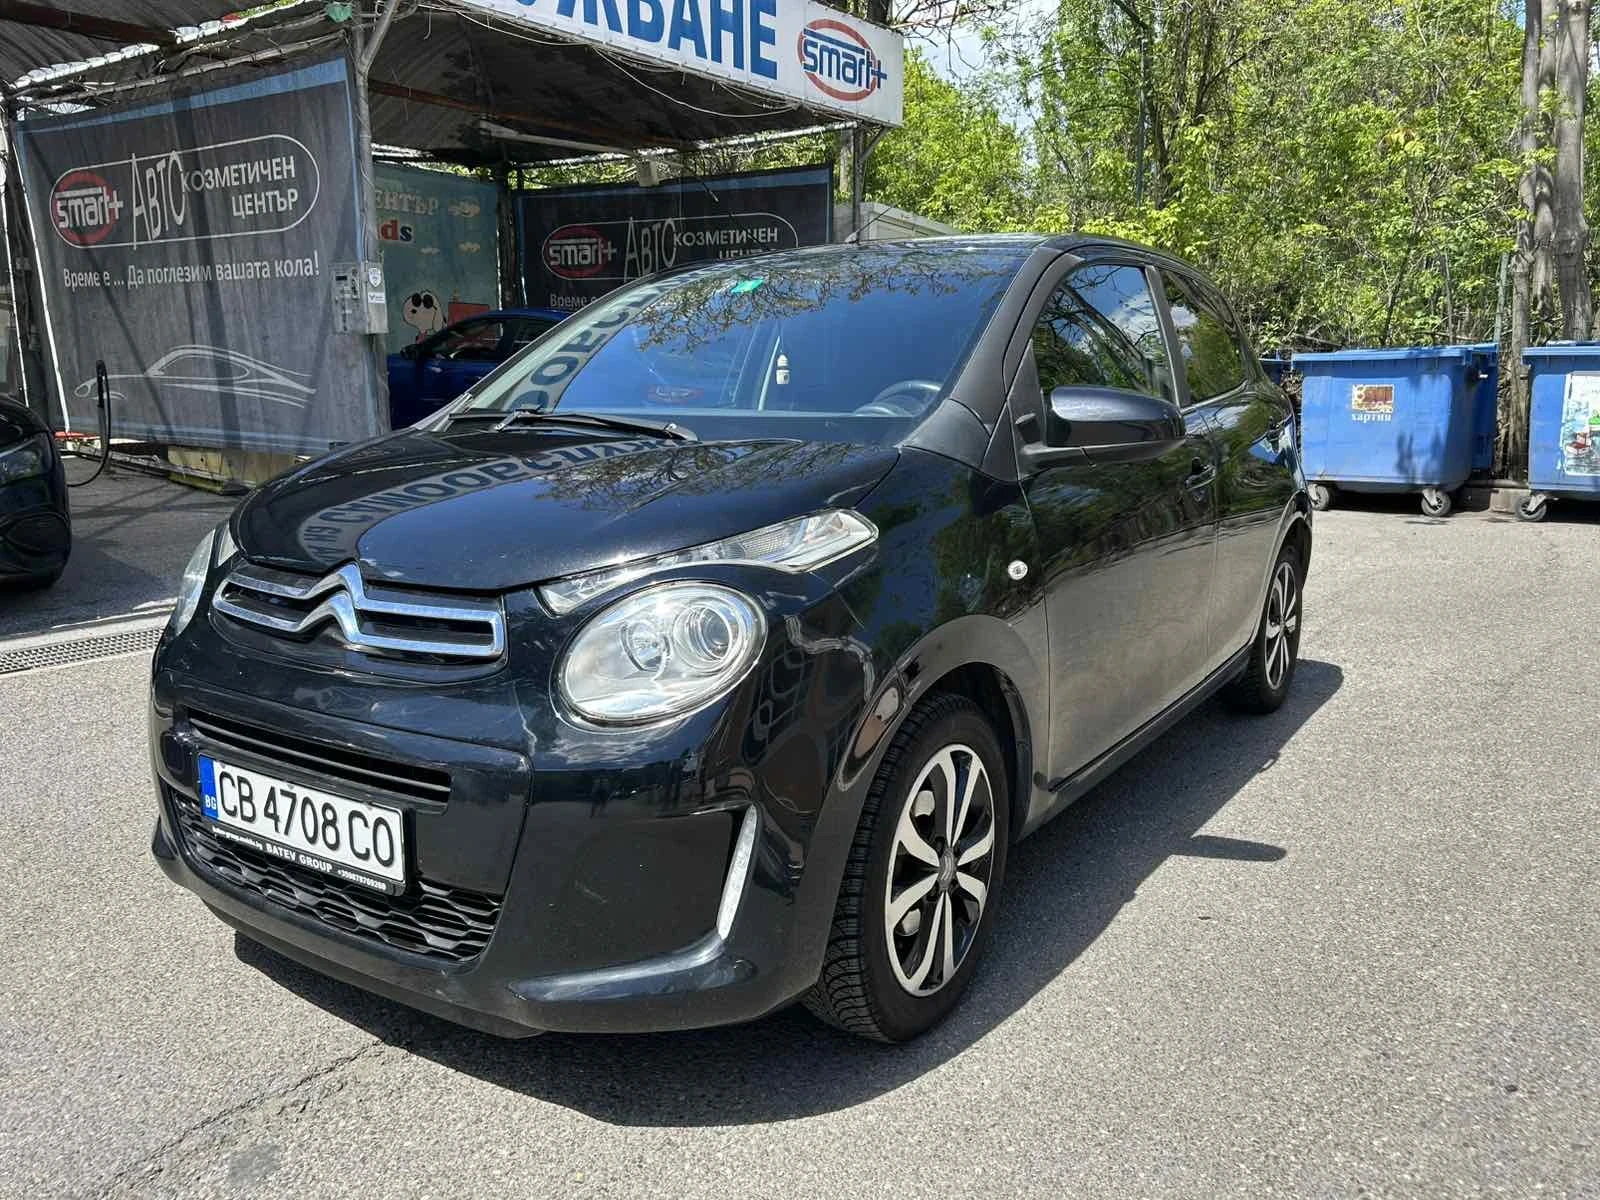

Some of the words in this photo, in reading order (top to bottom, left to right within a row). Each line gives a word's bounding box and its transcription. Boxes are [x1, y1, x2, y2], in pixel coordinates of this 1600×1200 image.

[232, 188, 298, 219] ЦЕНТЪР
[63, 267, 100, 291] Време
[127, 265, 144, 289] Да
[147, 265, 212, 285] поглезим
[215, 262, 270, 281] вашата
[275, 250, 320, 278] кола!
[205, 794, 217, 810] BG
[219, 771, 257, 823] CB
[264, 786, 340, 850] 4708
[348, 810, 394, 867] CO
[265, 843, 296, 861] BATEV
[299, 854, 333, 873] GROUP
